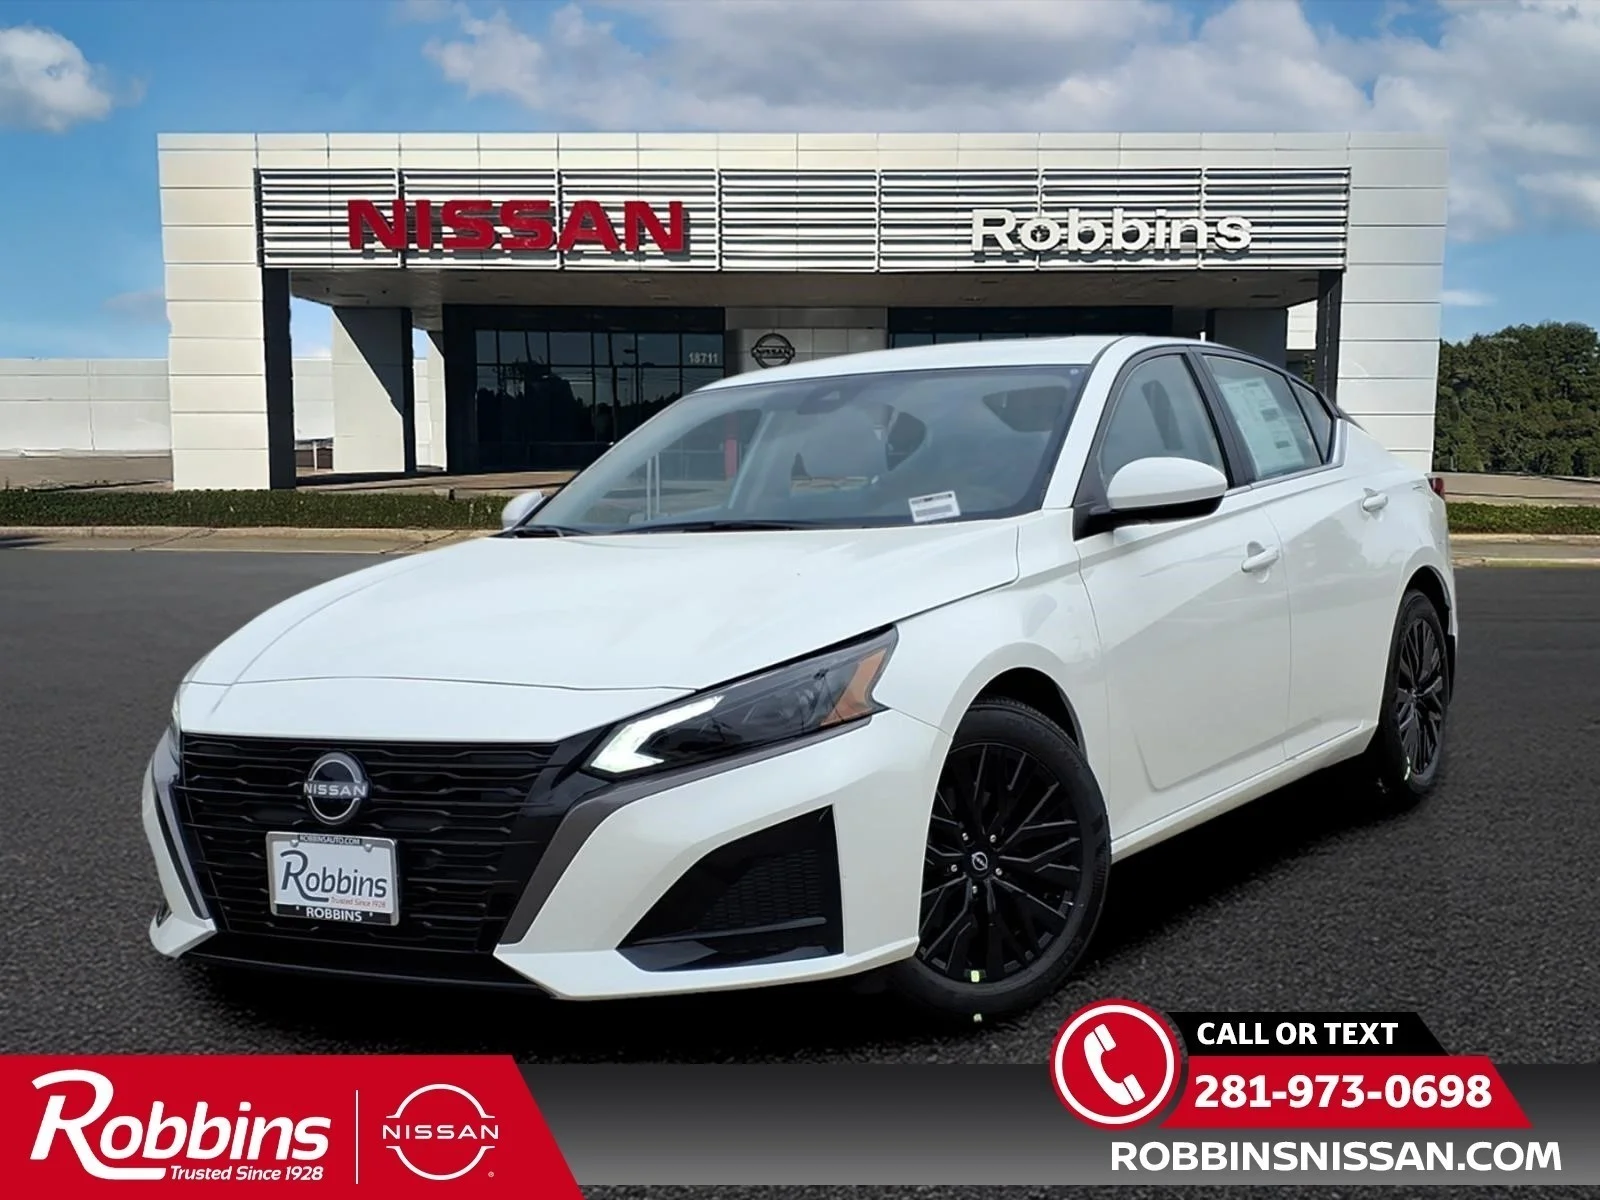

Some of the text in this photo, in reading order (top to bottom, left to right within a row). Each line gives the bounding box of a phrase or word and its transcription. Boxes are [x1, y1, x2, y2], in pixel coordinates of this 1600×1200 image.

[346, 199, 684, 252] NISSAN
[971, 208, 1252, 251] Robbins
[688, 352, 718, 364] 18711
[303, 782, 368, 797] NISSAN
[280, 850, 387, 902] Robbins
[306, 907, 362, 922] ROBBINS
